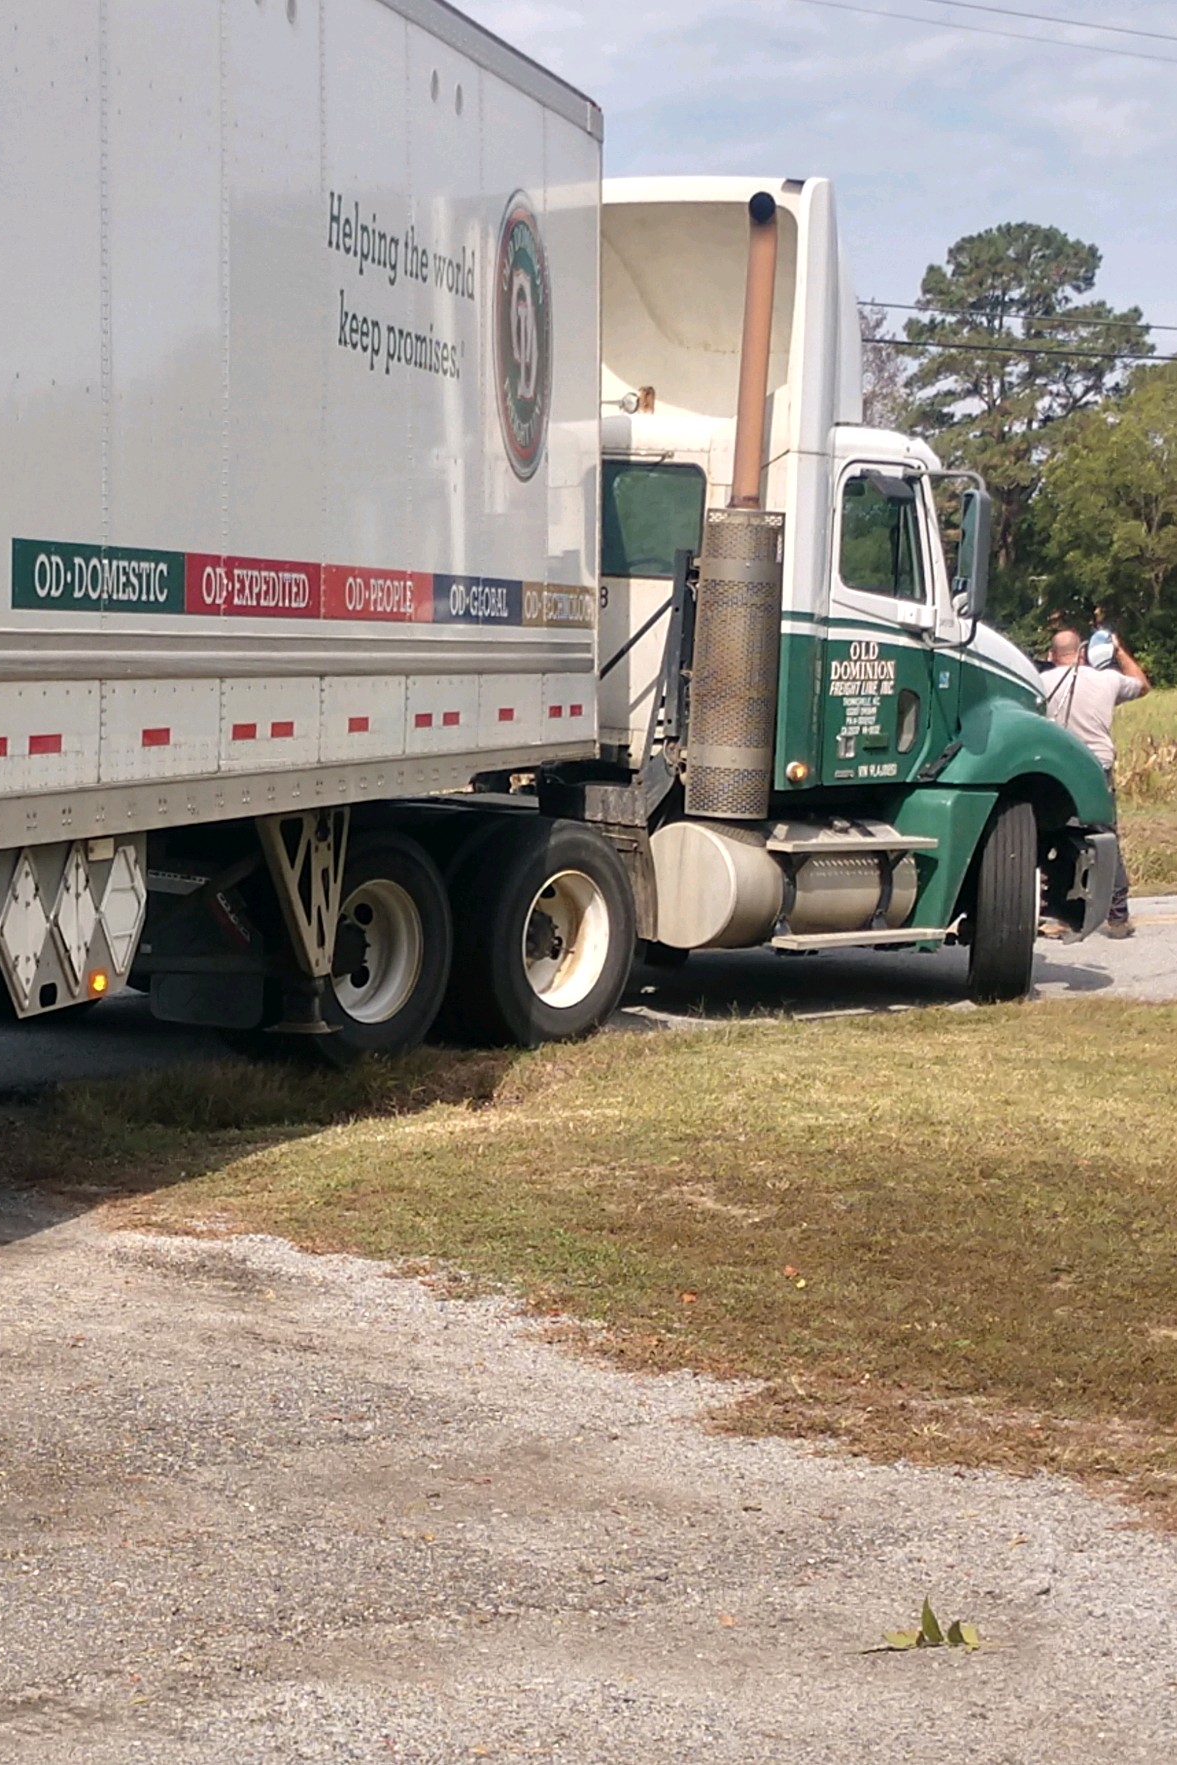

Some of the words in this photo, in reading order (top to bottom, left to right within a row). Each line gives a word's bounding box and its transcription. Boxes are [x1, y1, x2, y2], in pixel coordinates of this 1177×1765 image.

[327, 191, 399, 286] Helping
[404, 226, 428, 284] the
[433, 245, 475, 300] world
[337, 289, 382, 371] keep
[830, 660, 896, 681] DOMINION
[849, 641, 879, 661] OLD
